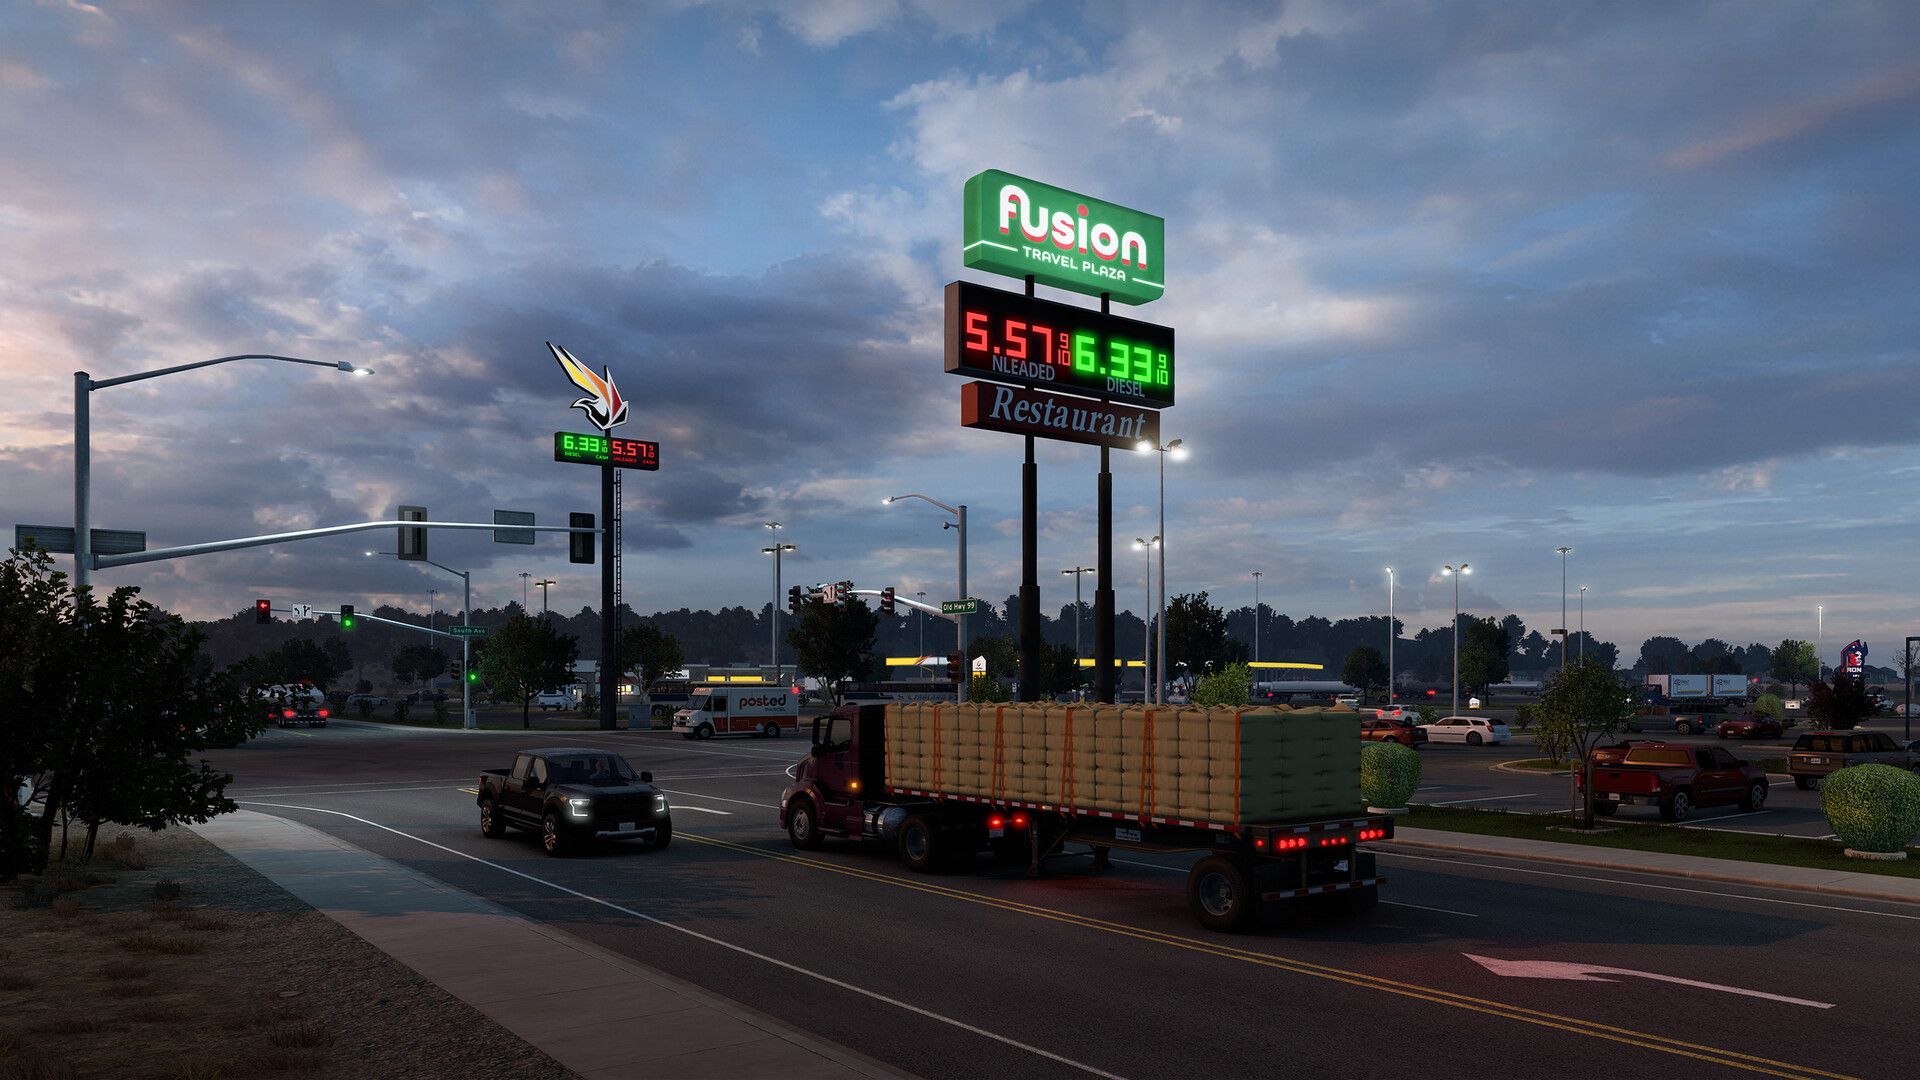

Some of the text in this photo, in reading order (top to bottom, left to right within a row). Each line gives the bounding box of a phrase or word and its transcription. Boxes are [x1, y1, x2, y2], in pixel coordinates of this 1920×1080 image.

[999, 184, 1147, 270] fusion
[1022, 245, 1126, 282] TRAVEL PLAZA
[966, 311, 1052, 364] 5.57
[1075, 334, 1152, 383] 6.33
[1107, 376, 1146, 398] DIESEL
[989, 386, 1146, 439] Restaurant
[563, 435, 600, 453] 6.33
[612, 440, 647, 458] 5.57
[967, 601, 975, 609] 99
[739, 694, 787, 710] posted
